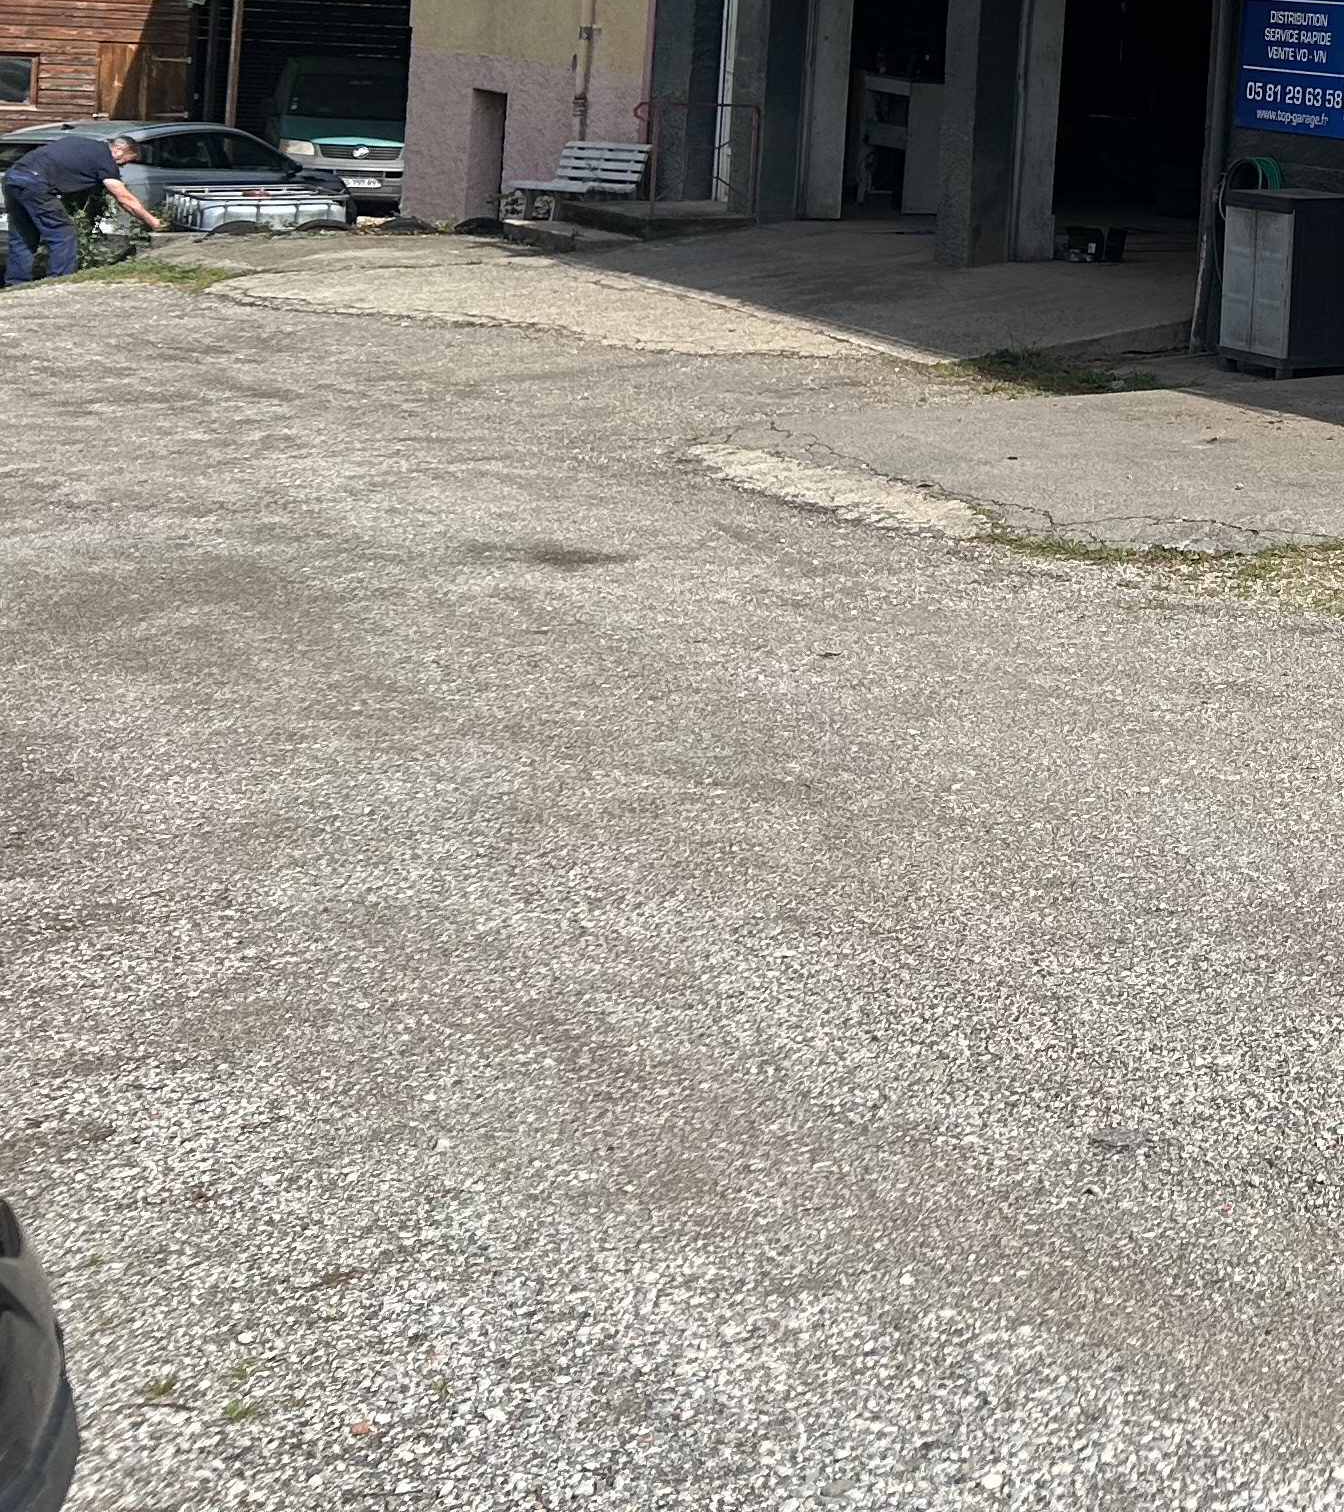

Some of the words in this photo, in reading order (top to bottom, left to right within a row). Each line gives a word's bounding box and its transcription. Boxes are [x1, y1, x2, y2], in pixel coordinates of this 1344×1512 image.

[1270, 10, 1328, 27] DISTRIBUTION
[1264, 28, 1299, 43] SERVICE
[1300, 31, 1332, 45] RAPIDE
[1268, 46, 1295, 61] VENTE
[1296, 49, 1308, 62] VO
[1314, 50, 1327, 63] VN
[1246, 82, 1263, 100] 05
[1265, 84, 1281, 102] 81
[1285, 86, 1302, 104] 29
[1305, 88, 1322, 106] 63
[1325, 90, 1343, 108] 58
[1256, 109, 1329, 128] www.top-garage.fr
